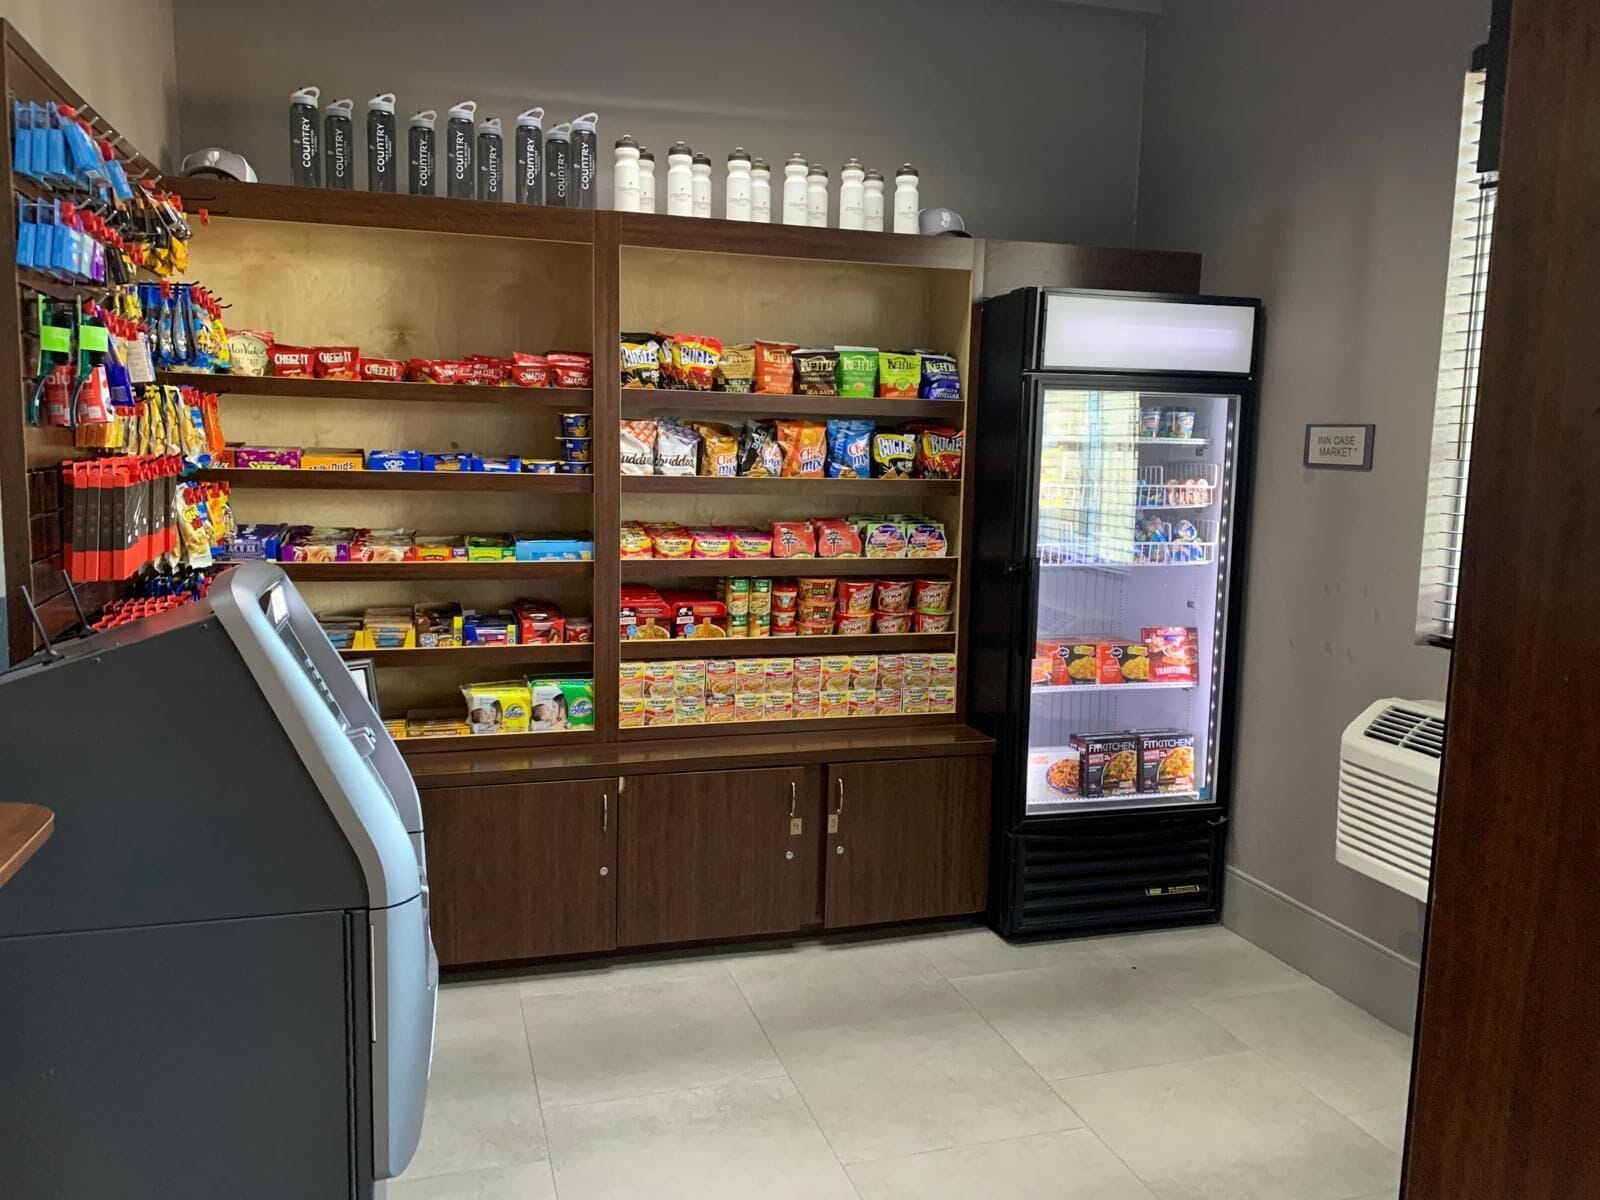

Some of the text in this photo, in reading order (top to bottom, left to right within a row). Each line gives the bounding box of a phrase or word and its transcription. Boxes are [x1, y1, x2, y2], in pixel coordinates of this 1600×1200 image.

[302, 116, 311, 168] COUNTRY
[335, 127, 344, 178] COUNTRY
[376, 122, 385, 173] COUNTRY
[419, 138, 428, 187] COUNTRY
[455, 130, 465, 180] COUNTRY
[526, 137, 535, 187] COUNTRY
[581, 141, 590, 191] COUNTRY
[489, 145, 497, 193] COUNTRY
[798, 447, 825, 460] Chex
[800, 458, 824, 472] mix
[876, 436, 914, 459] BUGLES
[1318, 436, 1356, 446] INN CASE
[780, 528, 798, 553] 辛
[826, 528, 843, 553] 辛
